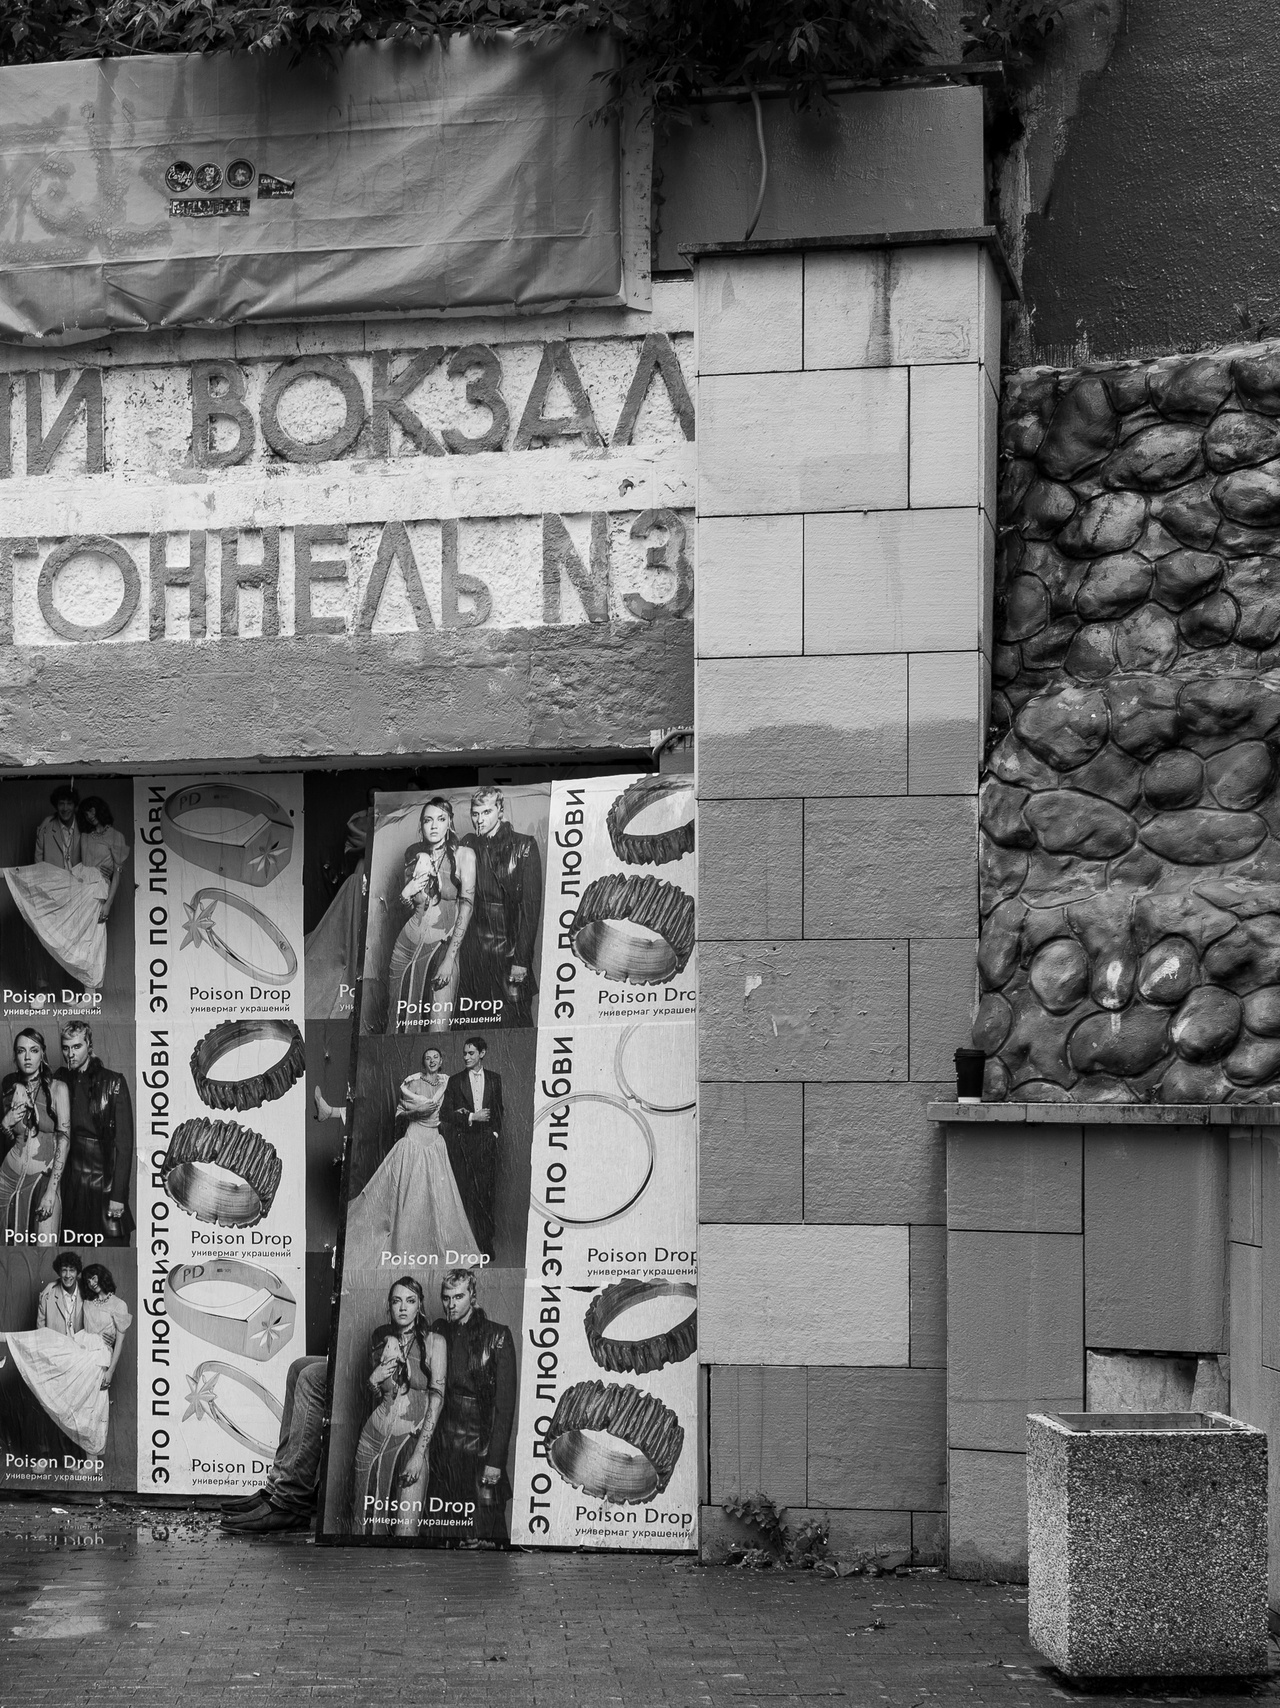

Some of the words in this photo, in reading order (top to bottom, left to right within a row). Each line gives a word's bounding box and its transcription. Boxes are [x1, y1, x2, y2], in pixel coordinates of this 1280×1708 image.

[190, 332, 695, 468] ВОКЗАЛ
[3, 989, 57, 1004] Poison
[61, 990, 103, 1007] Drop
[190, 986, 244, 1001] Poison
[249, 987, 291, 1004] Drop
[599, 990, 657, 1004] Poison
[665, 988, 696, 1001] Dro
[3, 1008, 50, 1017] универмаг
[52, 1006, 102, 1016] украшений
[190, 1005, 238, 1014] универмаг
[240, 1004, 290, 1014] украшений
[397, 1000, 453, 1014] Poison
[460, 997, 503, 1014] Drop
[599, 1009, 650, 1018] универмаг
[653, 1007, 696, 1016] украшен
[396, 1018, 446, 1028] универмаг
[448, 1014, 502, 1025] украшений
[5, 1229, 57, 1243] Poison
[63, 1229, 104, 1247] Drop
[191, 1230, 245, 1245] Poison
[251, 1231, 292, 1249] Drop
[191, 1250, 239, 1258] универмаг
[241, 1249, 291, 1258] украшений
[381, 1251, 438, 1265] Poison
[445, 1250, 490, 1268] Drop
[588, 1248, 646, 1262] Poison
[183, 1265, 204, 1282] PD
[587, 1269, 641, 1277] универмаг
[5, 1454, 58, 1469] Poison
[64, 1455, 105, 1471] Drop
[192, 1459, 245, 1473] Poison
[252, 1460, 272, 1474] Dr
[5, 1472, 52, 1482] универмаг
[54, 1473, 104, 1482] украшений
[192, 1478, 239, 1486] универмаг
[364, 1496, 422, 1511] Poison
[429, 1497, 475, 1517] Drop
[417, 1518, 474, 1527] украшений
[575, 1506, 637, 1523] Poison
[644, 1508, 693, 1526] Drop
[575, 1527, 629, 1538] универмаг
[632, 1529, 692, 1538] украшений
